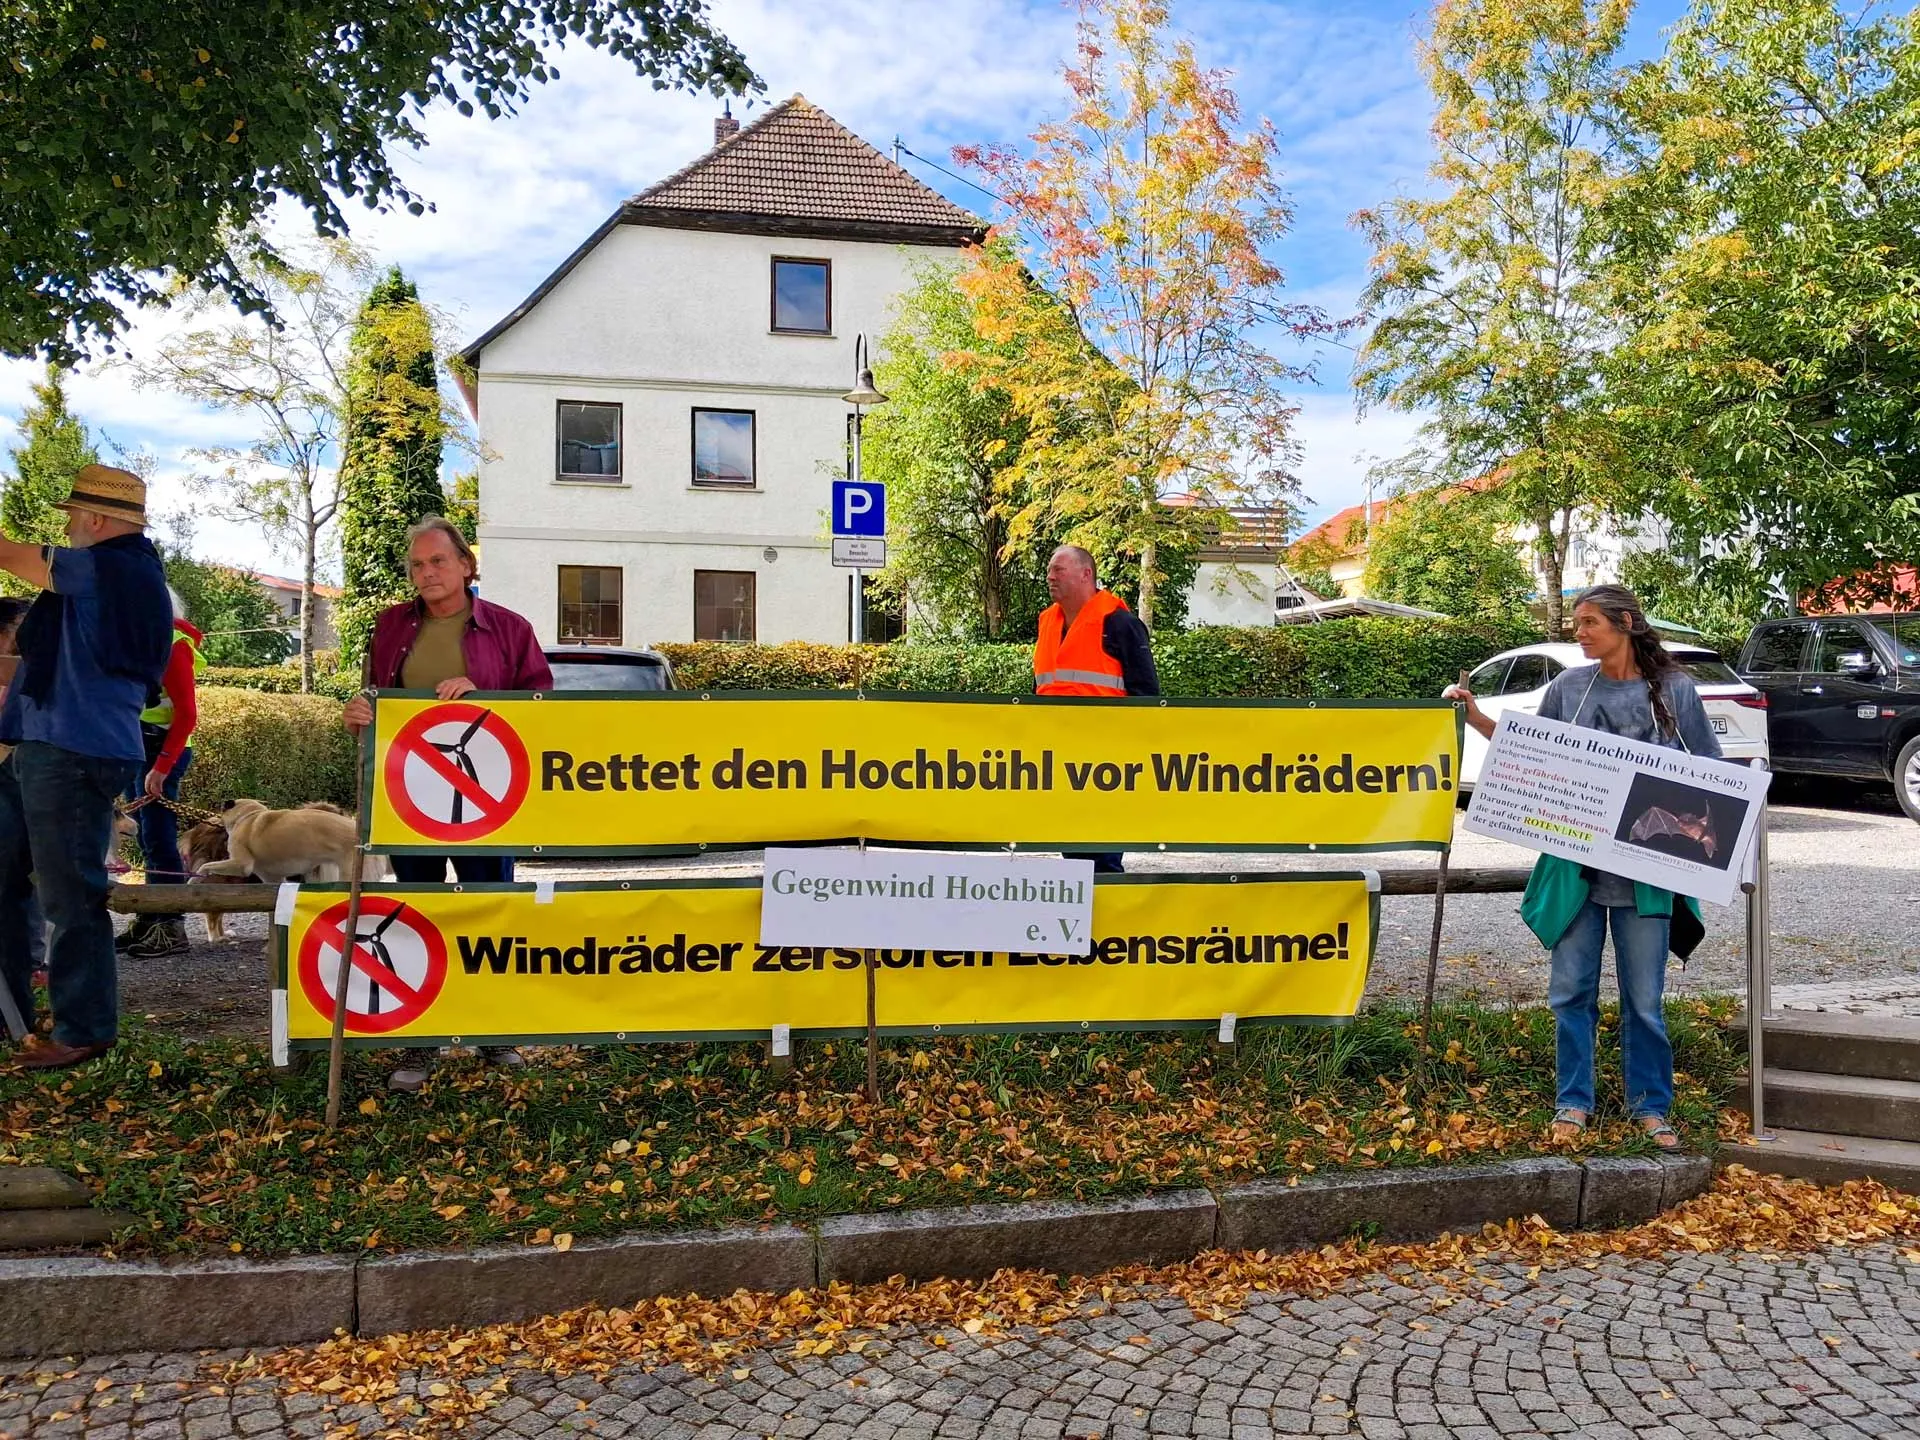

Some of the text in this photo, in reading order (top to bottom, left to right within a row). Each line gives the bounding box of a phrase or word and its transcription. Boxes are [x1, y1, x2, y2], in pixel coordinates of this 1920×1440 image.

[844, 488, 872, 529] P
[1507, 720, 1550, 741] Rettet
[1554, 733, 1580, 749] den
[1586, 739, 1661, 769] Hochbühl
[542, 748, 1453, 793] Rettet den Hochbühl vor Windrädern!
[1488, 769, 1536, 788] Aussterben
[1578, 792, 1604, 806] Arten
[1499, 761, 1521, 772] stark
[1522, 766, 1569, 785] gefährdete
[1590, 784, 1609, 795] vom
[1480, 792, 1519, 809] Darunter
[1520, 803, 1535, 814] die
[1484, 780, 1498, 789] am
[1500, 783, 1543, 800] Hochbühl
[1472, 814, 1488, 825] der
[1488, 820, 1540, 839] gefährdeten
[1475, 804, 1593, 842] die auf der ROTEN LISTE
[771, 869, 1085, 905] Gegenwind Hochbühl
[1026, 918, 1083, 943] e. V.
[457, 934, 744, 975] Windräder
[752, 943, 994, 971] zersren
